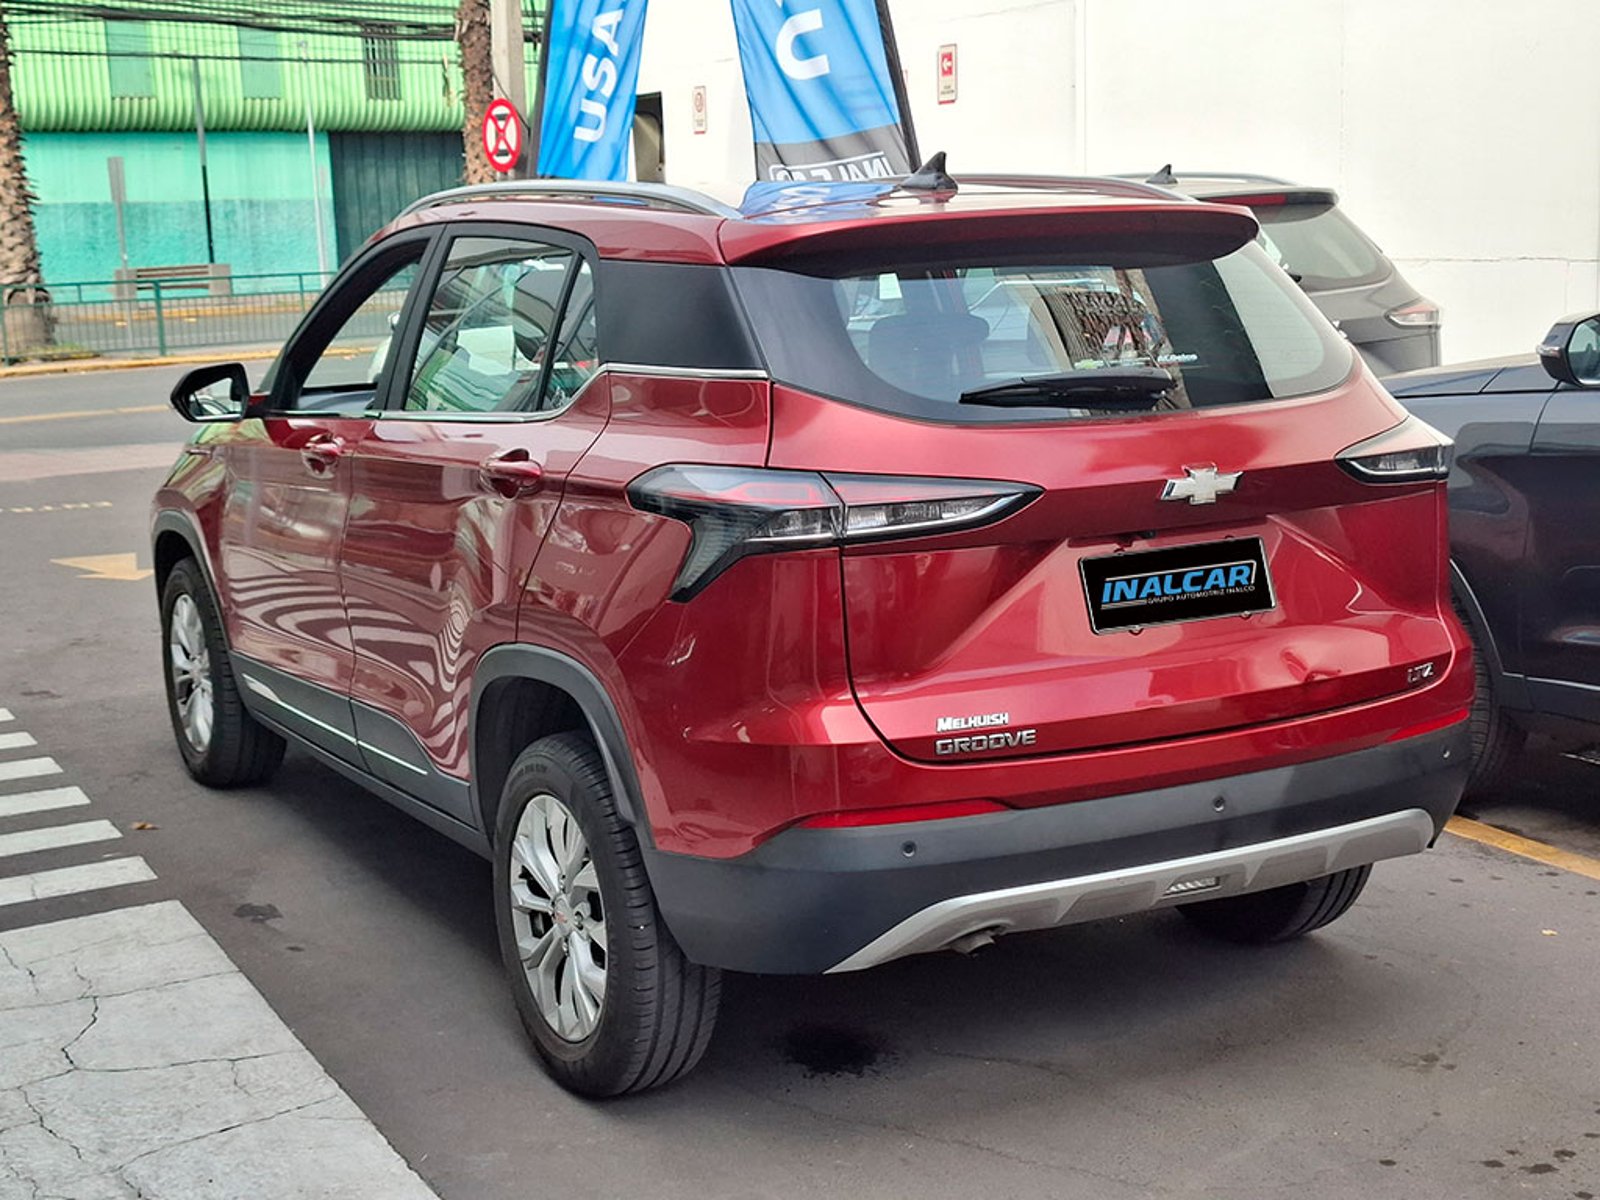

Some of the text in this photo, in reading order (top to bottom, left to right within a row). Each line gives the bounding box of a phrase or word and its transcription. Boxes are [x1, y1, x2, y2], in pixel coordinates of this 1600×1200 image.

[573, 9, 624, 142] USA
[1102, 565, 1251, 603] INALCAR
[935, 729, 1036, 755] GROOVE
